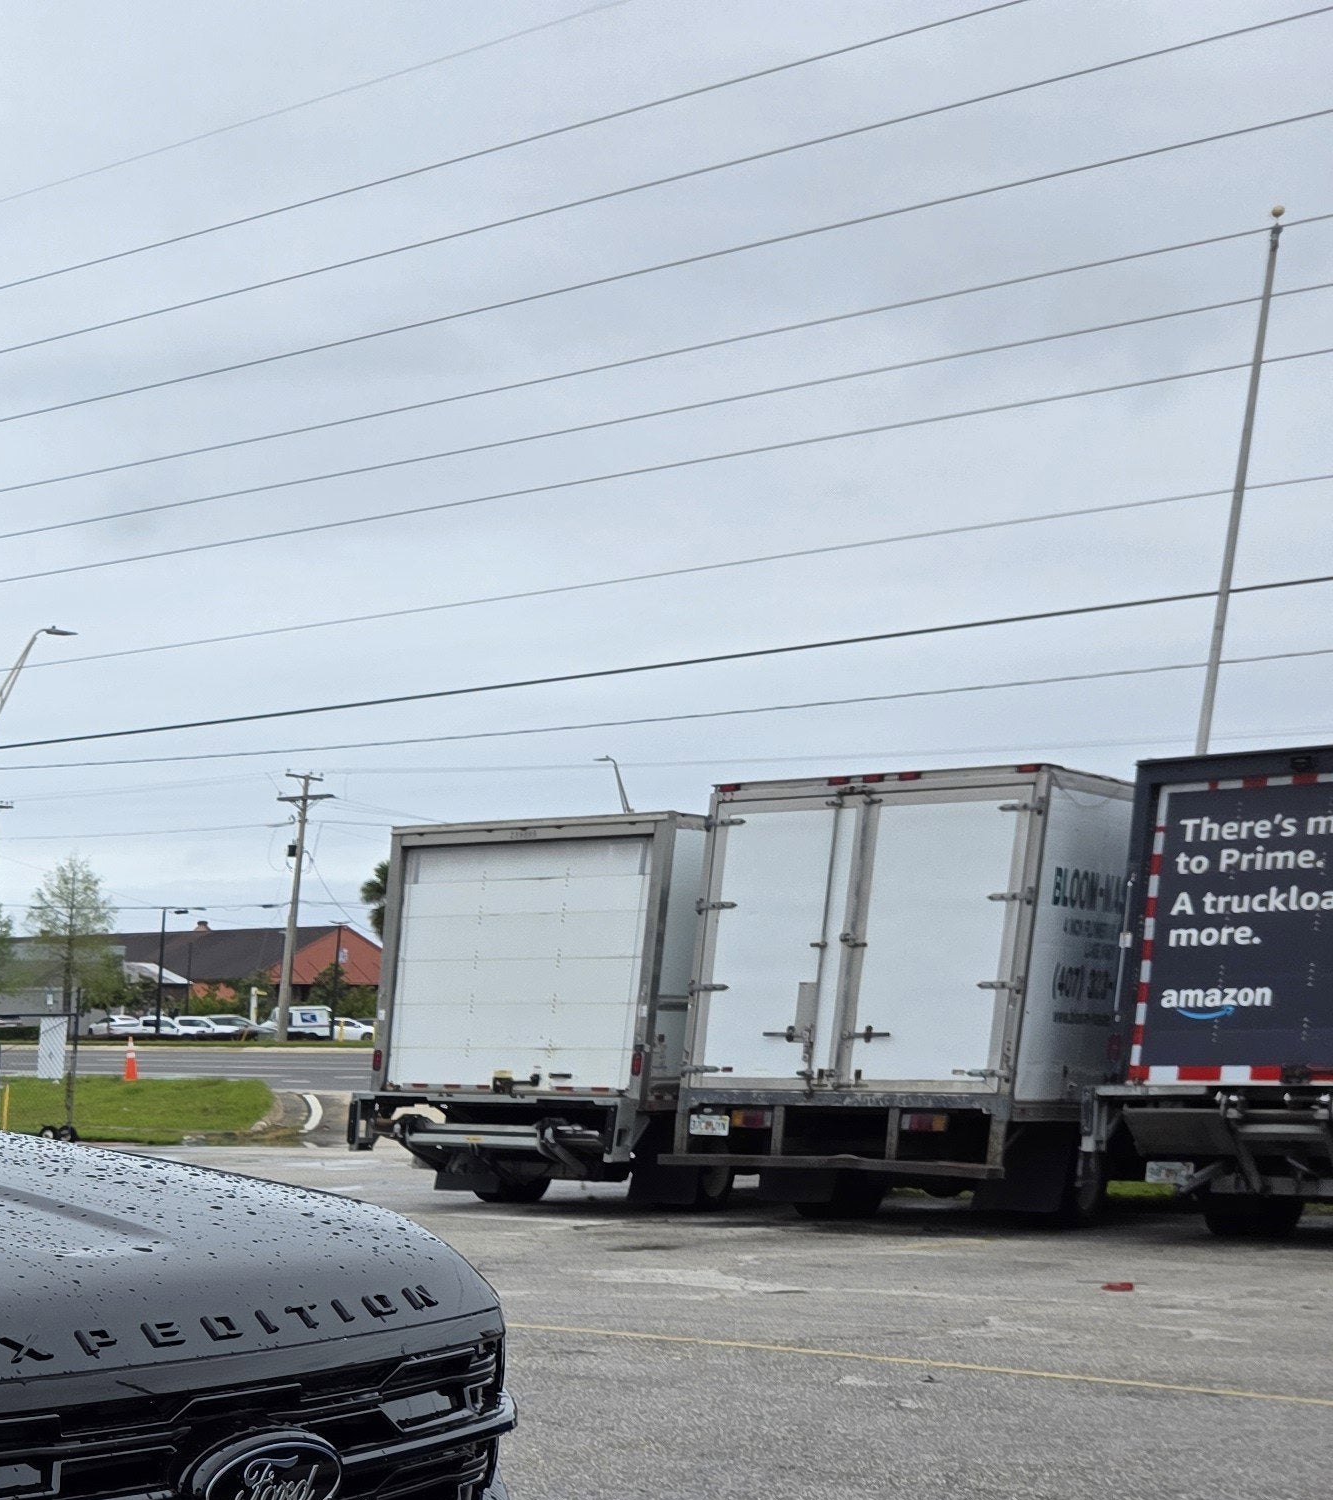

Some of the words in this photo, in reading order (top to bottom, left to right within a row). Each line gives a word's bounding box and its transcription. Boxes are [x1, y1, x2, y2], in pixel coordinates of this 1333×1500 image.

[1180, 813, 1298, 843] There's
[1175, 852, 1209, 875] to
[1219, 845, 1325, 873] Prime.
[1170, 891, 1195, 916] A
[1168, 925, 1262, 947] more.
[1160, 986, 1273, 1009] amazon
